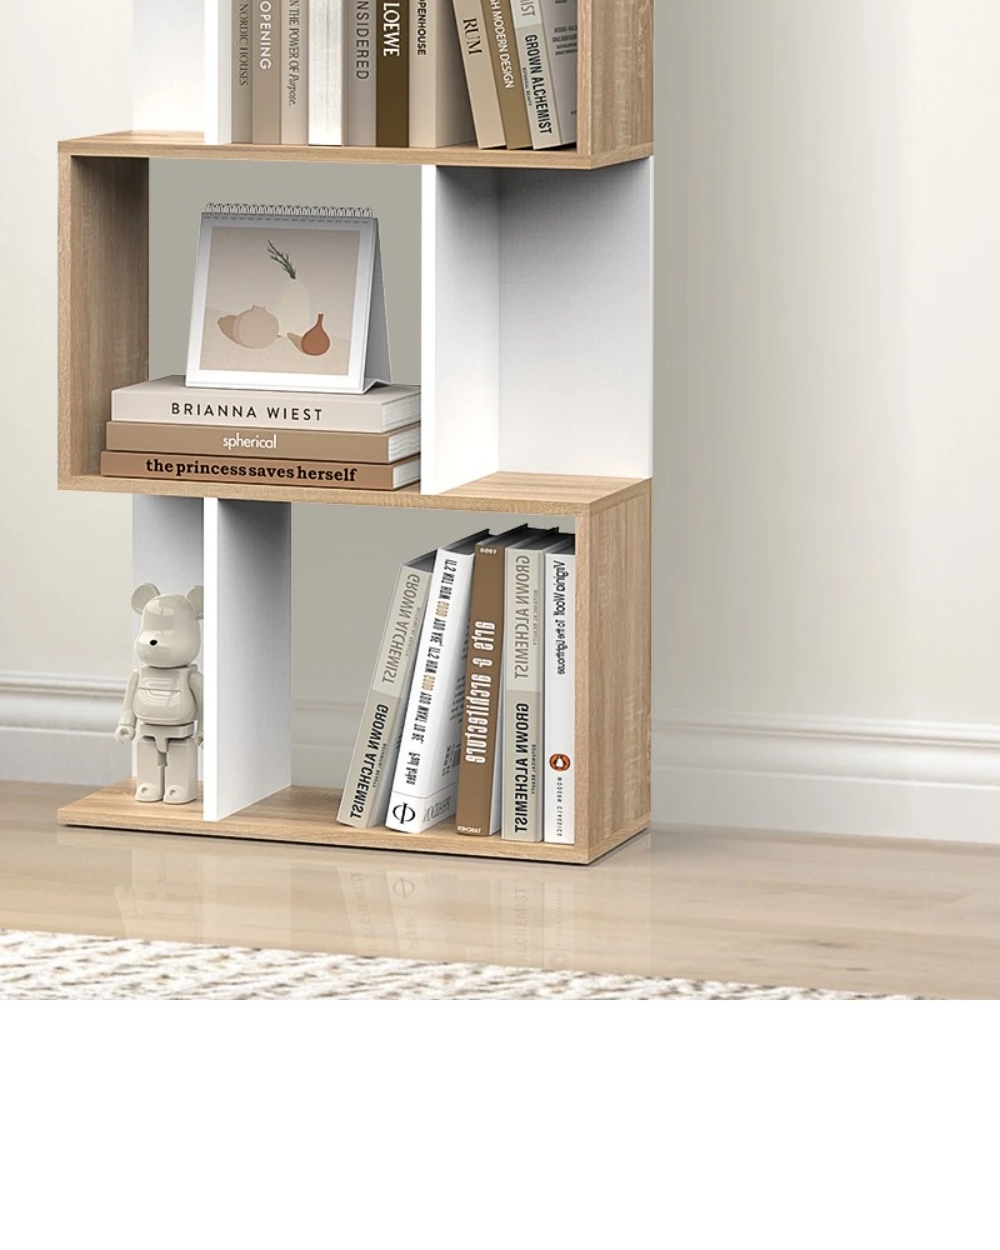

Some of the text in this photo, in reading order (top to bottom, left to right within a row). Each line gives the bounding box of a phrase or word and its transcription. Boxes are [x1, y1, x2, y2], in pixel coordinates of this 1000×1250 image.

[239, 3, 249, 45] NORDIC
[259, 0, 272, 70] OPENING
[288, 9, 300, 26] THE
[383, 2, 401, 57] LOEWE
[463, 17, 483, 55] RUM
[491, 10, 508, 53] MODERN
[288, 28, 300, 59] POWER
[239, 47, 249, 86] HOUSES
[288, 60, 300, 73] OF
[499, 53, 515, 89] DESIGN
[524, 34, 552, 135] GROWN ALCHEMIST
[171, 402, 322, 421] BRIANNA WIEST
[223, 432, 277, 450] spherical
[145, 458, 358, 482] the princess saves herself
